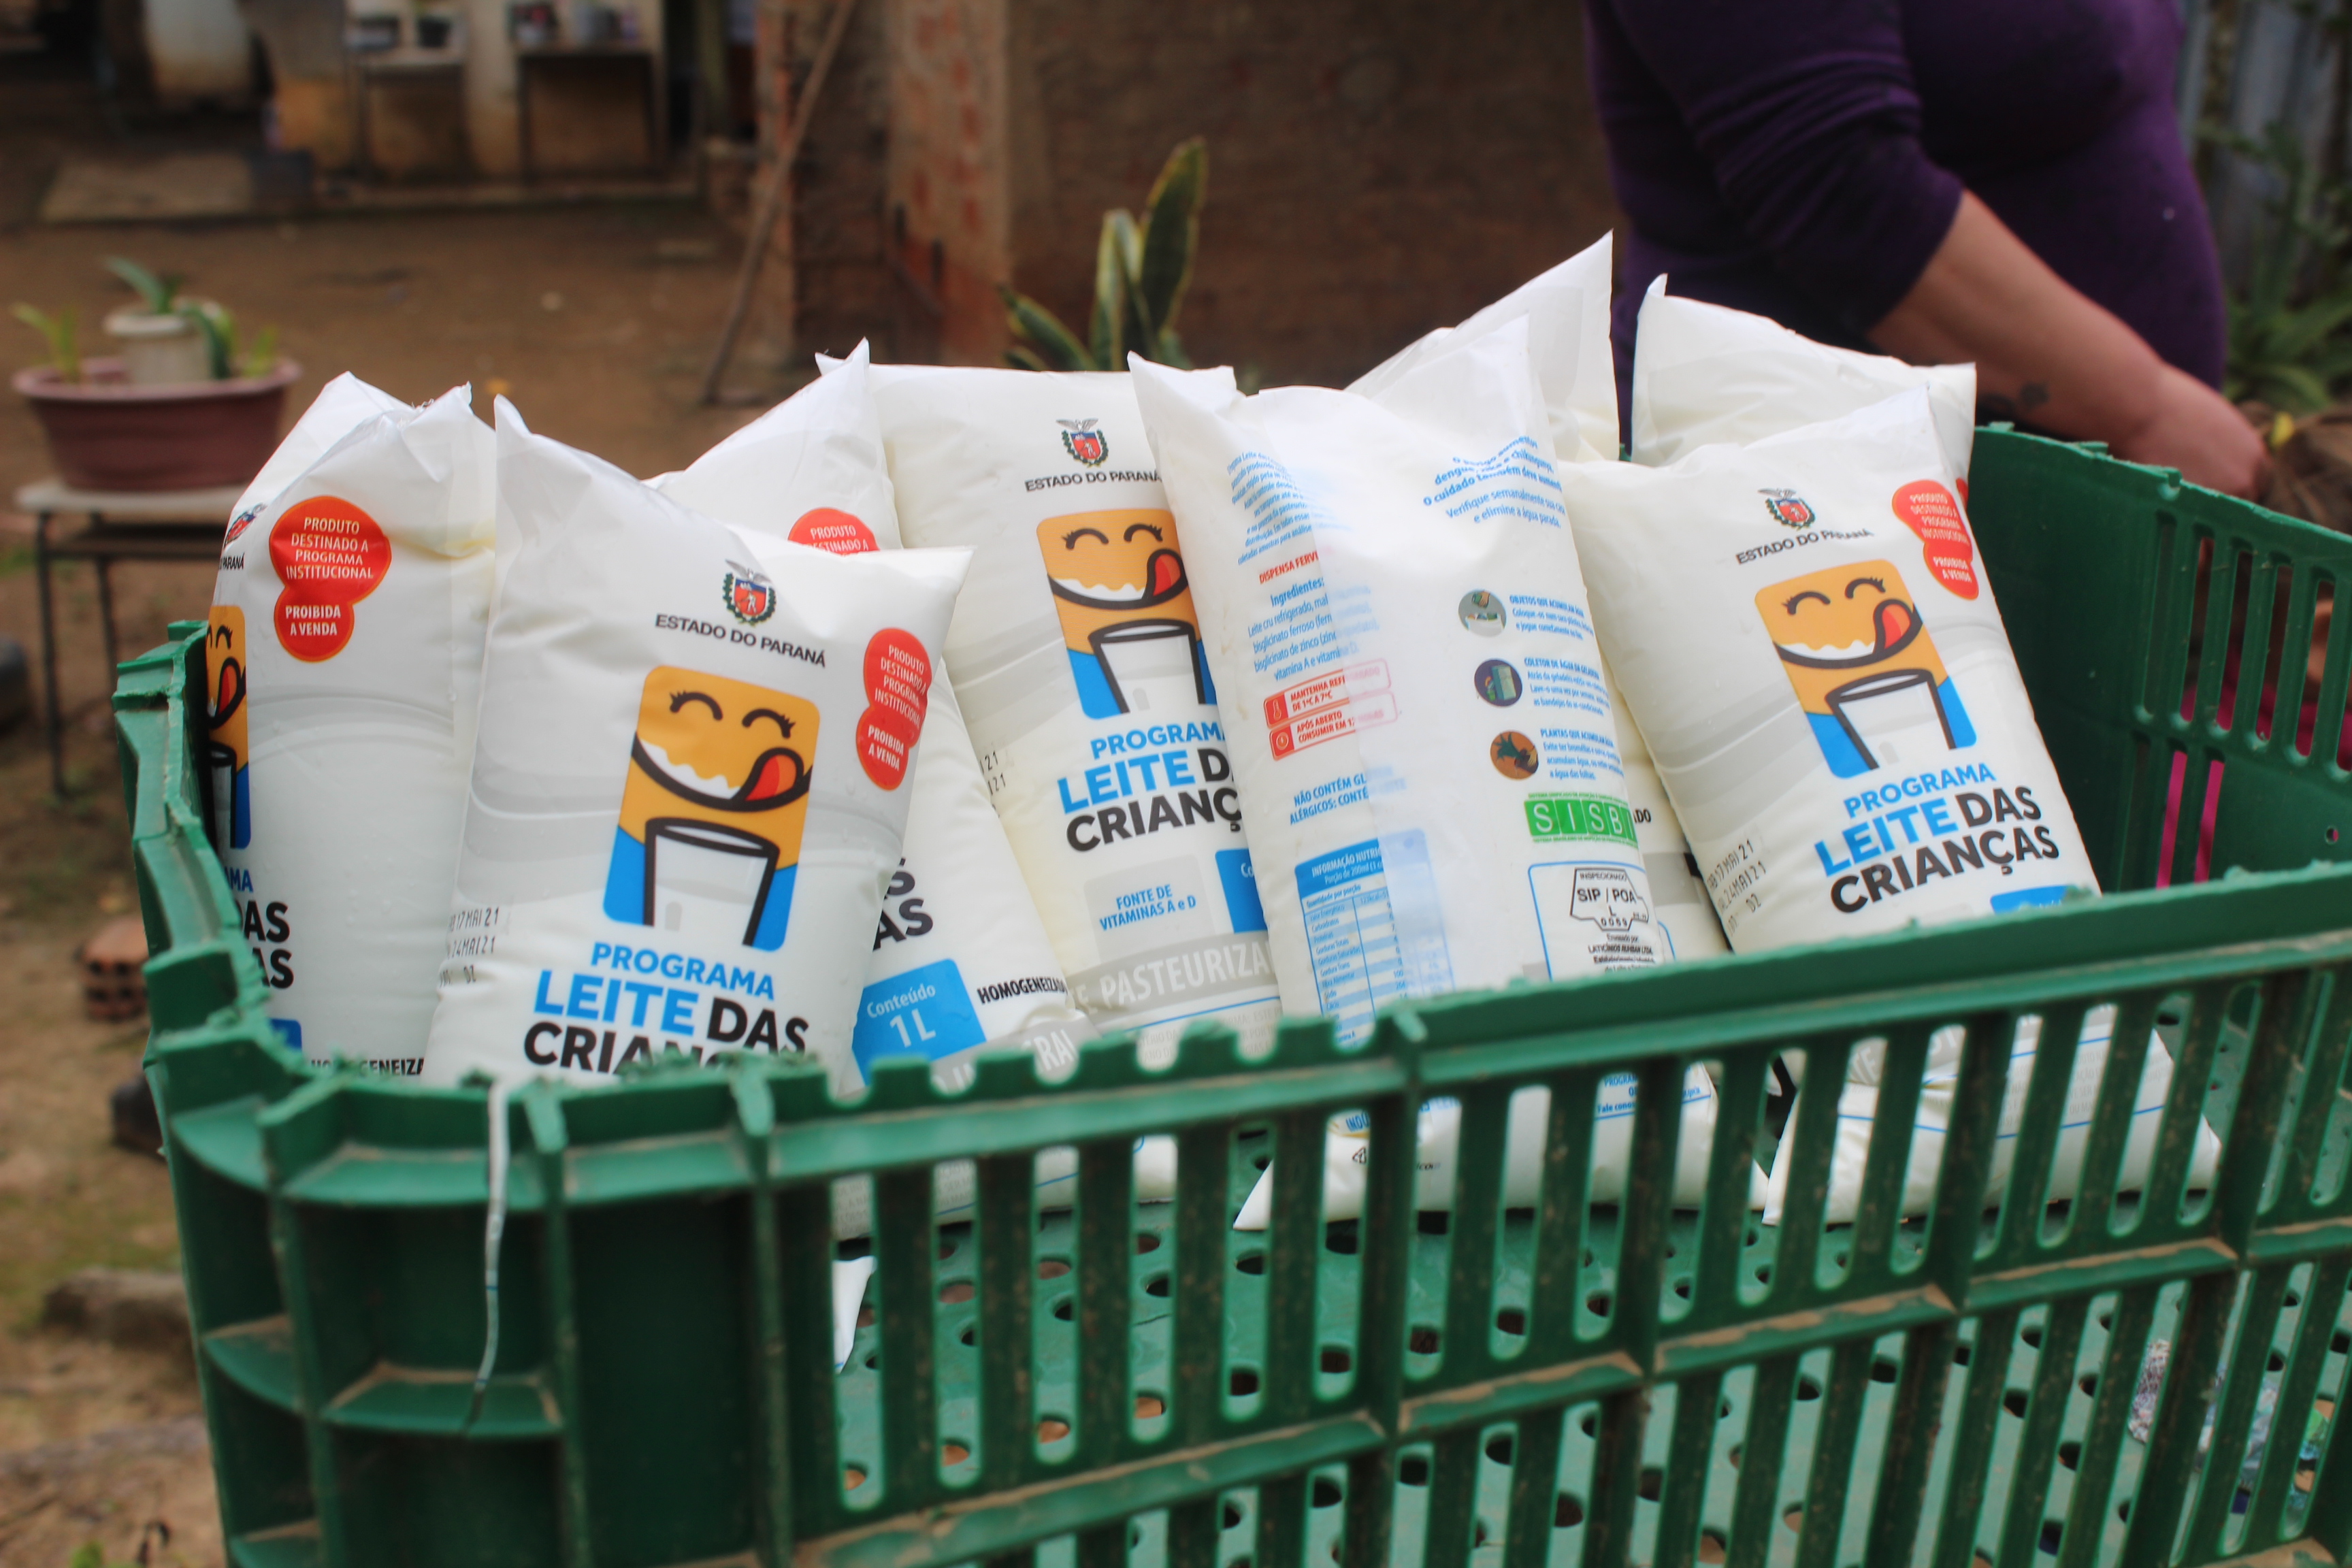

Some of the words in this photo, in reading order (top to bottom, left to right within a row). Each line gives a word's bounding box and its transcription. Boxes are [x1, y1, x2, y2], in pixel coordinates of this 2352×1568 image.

[1024, 472, 1083, 492] ESTADO
[1085, 470, 1107, 483] DO
[1109, 468, 1163, 483] PARANÁ
[1423, 496, 1433, 506] O
[1433, 476, 1475, 503] cuidado
[1446, 493, 1491, 519] Verifique
[1909, 492, 1948, 504] PRODUTO
[1910, 504, 1953, 518] DESTINADO
[304, 517, 360, 535] PRODUTO
[1473, 514, 1481, 523] e
[1481, 504, 1516, 520] elimine
[1921, 515, 1961, 531] PROGRAMA
[291, 533, 358, 553] DESTINADO
[361, 539, 368, 553] A
[810, 525, 857, 540] PRODUTO
[863, 539, 869, 551] A
[295, 549, 363, 566] PROGRAMA
[1735, 538, 1795, 566] ESTADO
[1797, 532, 1820, 547] DO
[1933, 556, 1970, 571] PROIBIDA
[286, 565, 374, 580] INSTITUCIONAL
[1259, 562, 1295, 585] DISPENSA
[1948, 569, 1973, 583] VENDA
[1270, 576, 1325, 608] Ingredientes:
[285, 604, 341, 619] PROIBIDA
[1247, 623, 1262, 638] Leite
[1263, 619, 1274, 630] cru
[1273, 602, 1314, 627] refrigerado,
[291, 622, 297, 636] A
[299, 621, 338, 636] VENDA
[655, 613, 727, 639] ESTADO
[730, 629, 757, 647] DO
[760, 636, 826, 668] PARANÁ
[1253, 630, 1289, 655] bisglicinato
[1289, 619, 1314, 639] ferroso
[889, 644, 925, 675] PRODUTO
[1254, 649, 1289, 674] bisglicinato
[1289, 644, 1298, 657] de
[1298, 635, 1320, 653] zinco
[880, 656, 922, 691] DESTINADO
[921, 682, 926, 696] A
[1273, 660, 1304, 683] vitamina
[1303, 656, 1310, 668] A
[1310, 657, 1317, 668] e
[883, 674, 920, 708] PROGRAMA
[1290, 683, 1328, 702] MANTENHA
[1292, 700, 1302, 713] DE
[1314, 694, 1320, 704] A
[875, 687, 921, 730] INSTITUCIONAL
[1296, 719, 1314, 734] APÓS
[1315, 710, 1342, 727] ABERTO
[868, 724, 904, 757] PROIBIDA
[1090, 721, 1226, 760] PROGRAM
[1298, 725, 1335, 743] CONSUMIR
[1335, 719, 1347, 733] EM
[1540, 728, 1569, 738] PLANTAS
[868, 742, 875, 756] A
[877, 747, 900, 772] VENDA
[1057, 750, 1196, 815] LEITE
[1294, 787, 1312, 808] NÃO
[1312, 775, 1352, 800] CONTÉM
[1843, 762, 1997, 819] PROGRAMA
[1290, 797, 1338, 826] ALÉRGICOS:
[1814, 797, 1959, 878] LEITE
[1955, 785, 2043, 829] DAS
[1311, 850, 1356, 879] INFORMAÇÃO
[1324, 870, 1343, 885] Porção
[1343, 868, 1350, 879] de
[1829, 825, 2060, 914] CRIANÇAS
[1116, 889, 1155, 910] FONTE
[1157, 884, 1173, 899] DE
[1577, 887, 1601, 902] SIP
[1612, 887, 1637, 904] POA
[235, 899, 291, 943] AS
[1099, 900, 1165, 931] VITAMINAS
[1166, 899, 1176, 915] A
[1177, 900, 1187, 911] e
[1187, 895, 1196, 909] D
[591, 941, 774, 1001] PROGRAMA
[1100, 941, 1275, 1007] PASTEURIZA
[534, 969, 699, 1036] LEITE
[706, 997, 810, 1058] DAS
[867, 983, 936, 1019] Conteúdo
